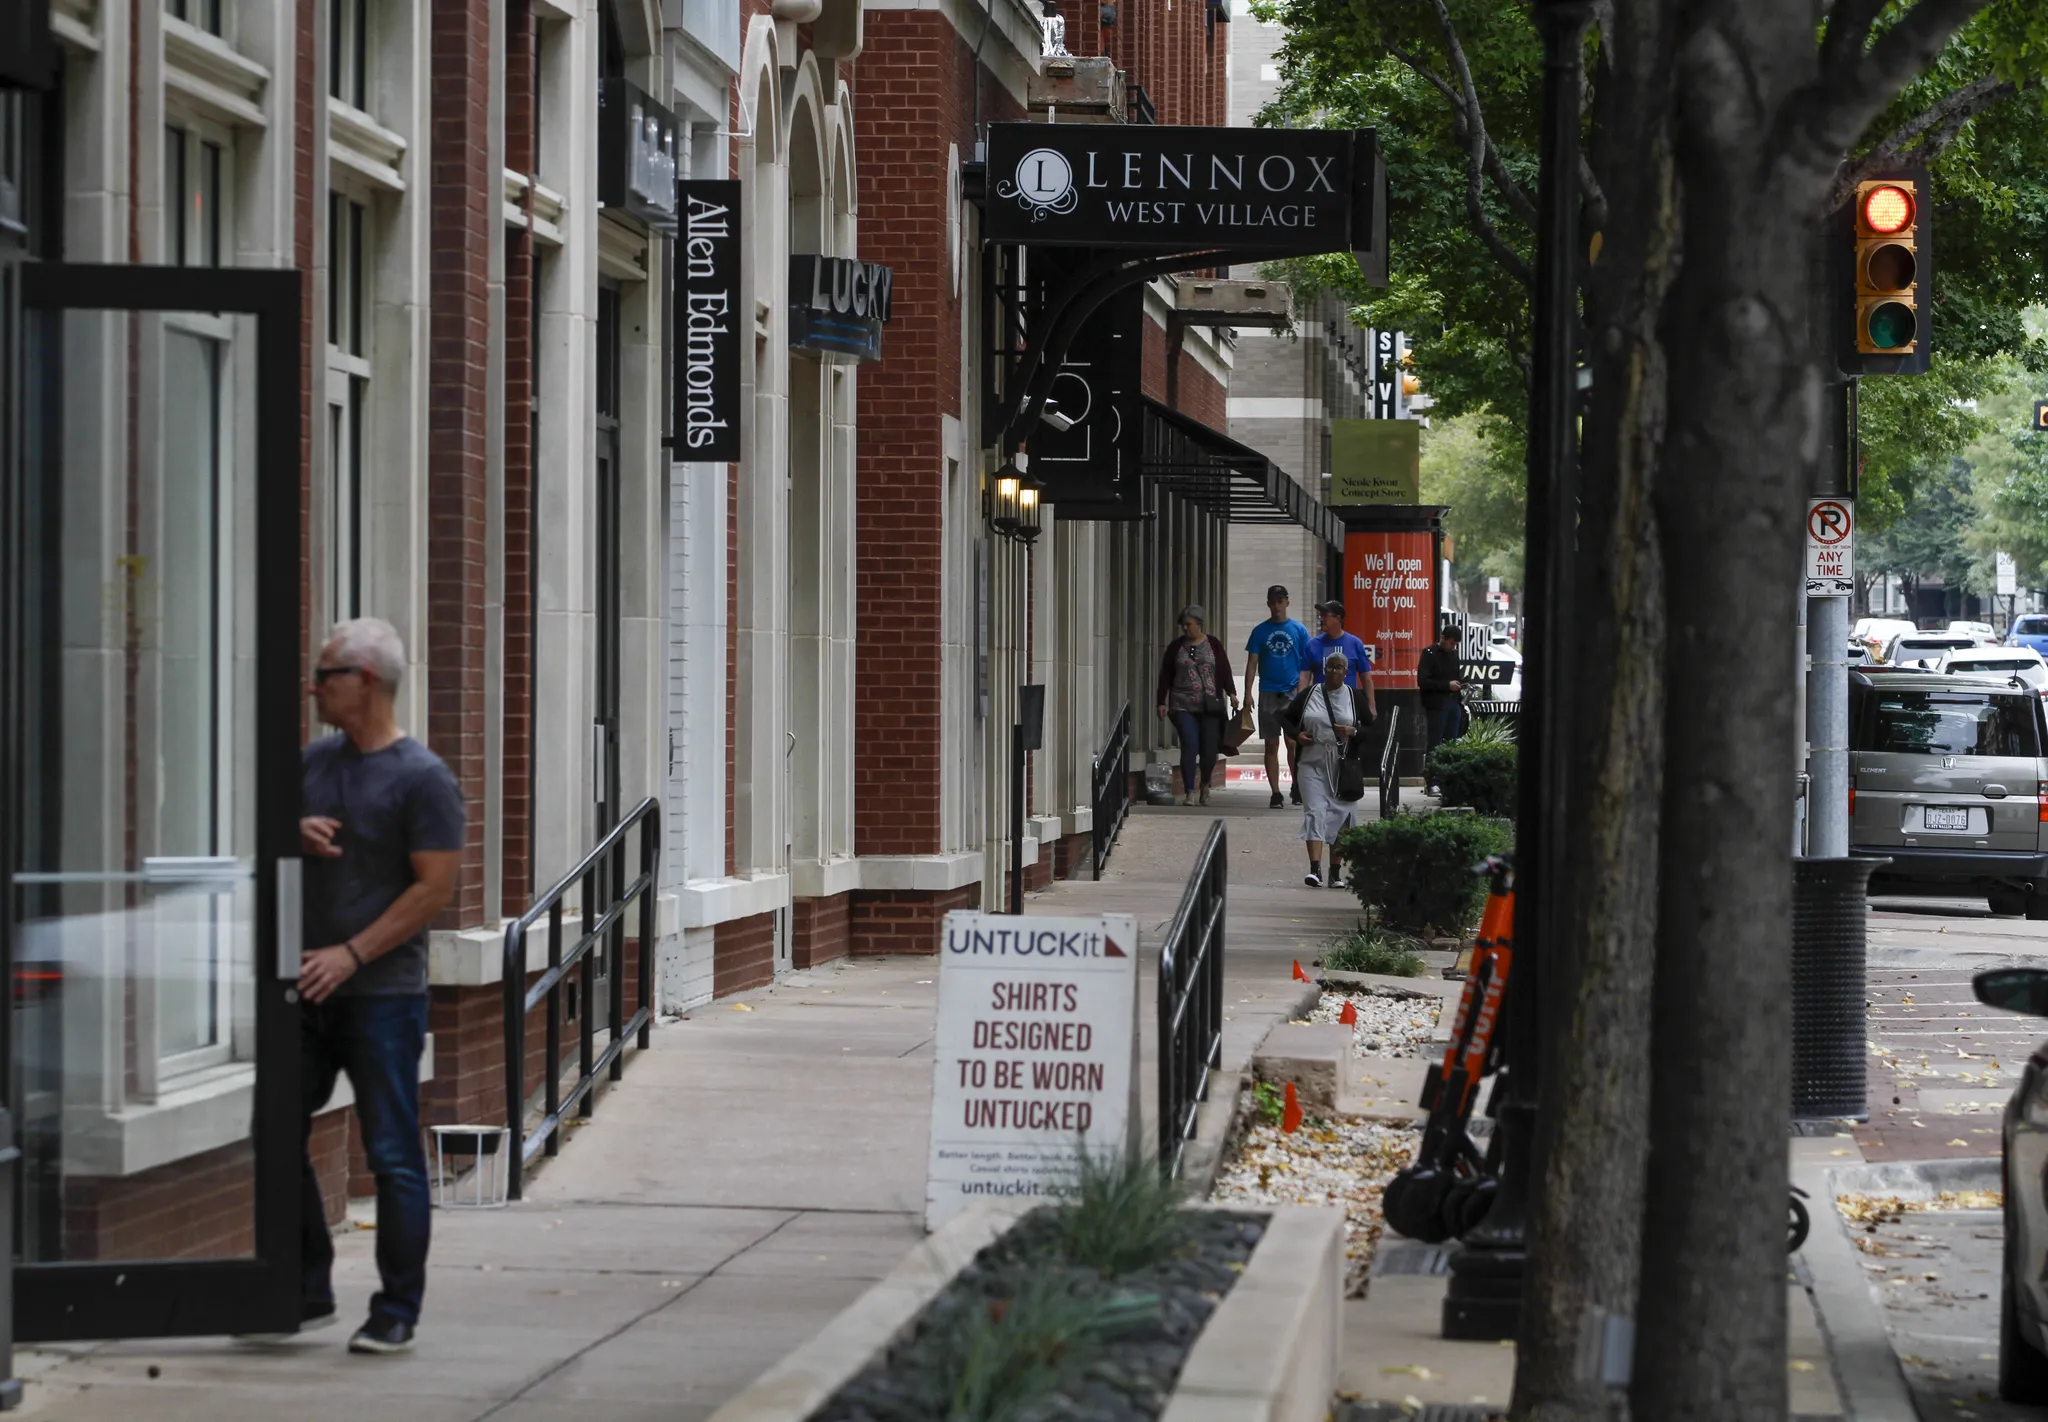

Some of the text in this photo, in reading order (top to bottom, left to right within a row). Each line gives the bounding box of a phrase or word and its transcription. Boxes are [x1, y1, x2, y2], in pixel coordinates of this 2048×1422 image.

[1086, 150, 1337, 194] LENNOX
[1105, 200, 1317, 228] WEST VILLAGE
[811, 254, 893, 322] LUCKY
[686, 194, 730, 449] Allen Edmonds
[1341, 488, 1407, 499] Concept Store
[1342, 477, 1398, 487] Nicole Kwon
[1365, 552, 1422, 575] We'll open
[1816, 564, 1843, 576] TIME
[1817, 551, 1843, 563] ANY
[1354, 571, 1430, 594] the right doors
[1372, 590, 1416, 612] for you.
[1376, 629, 1413, 641] Apply today!
[949, 929, 1101, 957] UNTUCKit
[991, 981, 1078, 1012] SHIRTS
[972, 1020, 1092, 1052] DESIGNED
[957, 1059, 1104, 1092] TO BE WORN
[963, 1099, 1092, 1130] UNTUCKED
